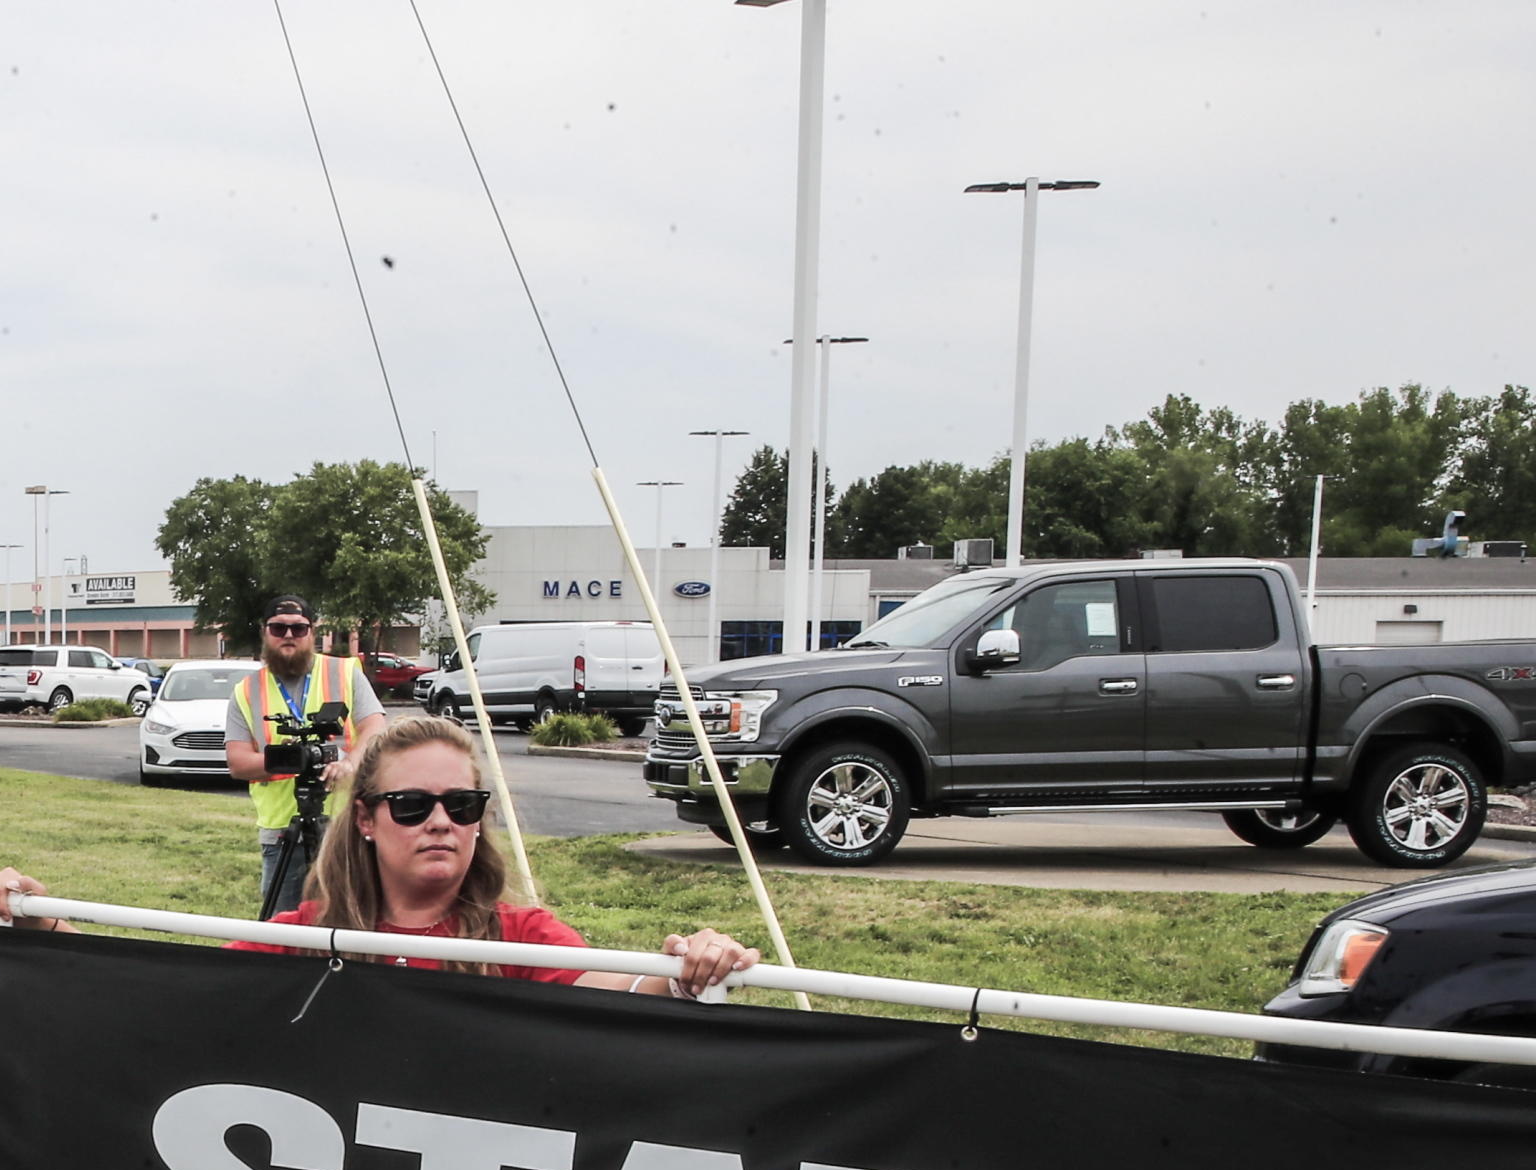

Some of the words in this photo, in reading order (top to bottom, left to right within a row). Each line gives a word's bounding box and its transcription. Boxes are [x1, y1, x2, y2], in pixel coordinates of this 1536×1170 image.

[87, 578, 133, 590] AVAILABLE
[543, 580, 622, 597] MACE
[681, 582, 706, 595] Ford
